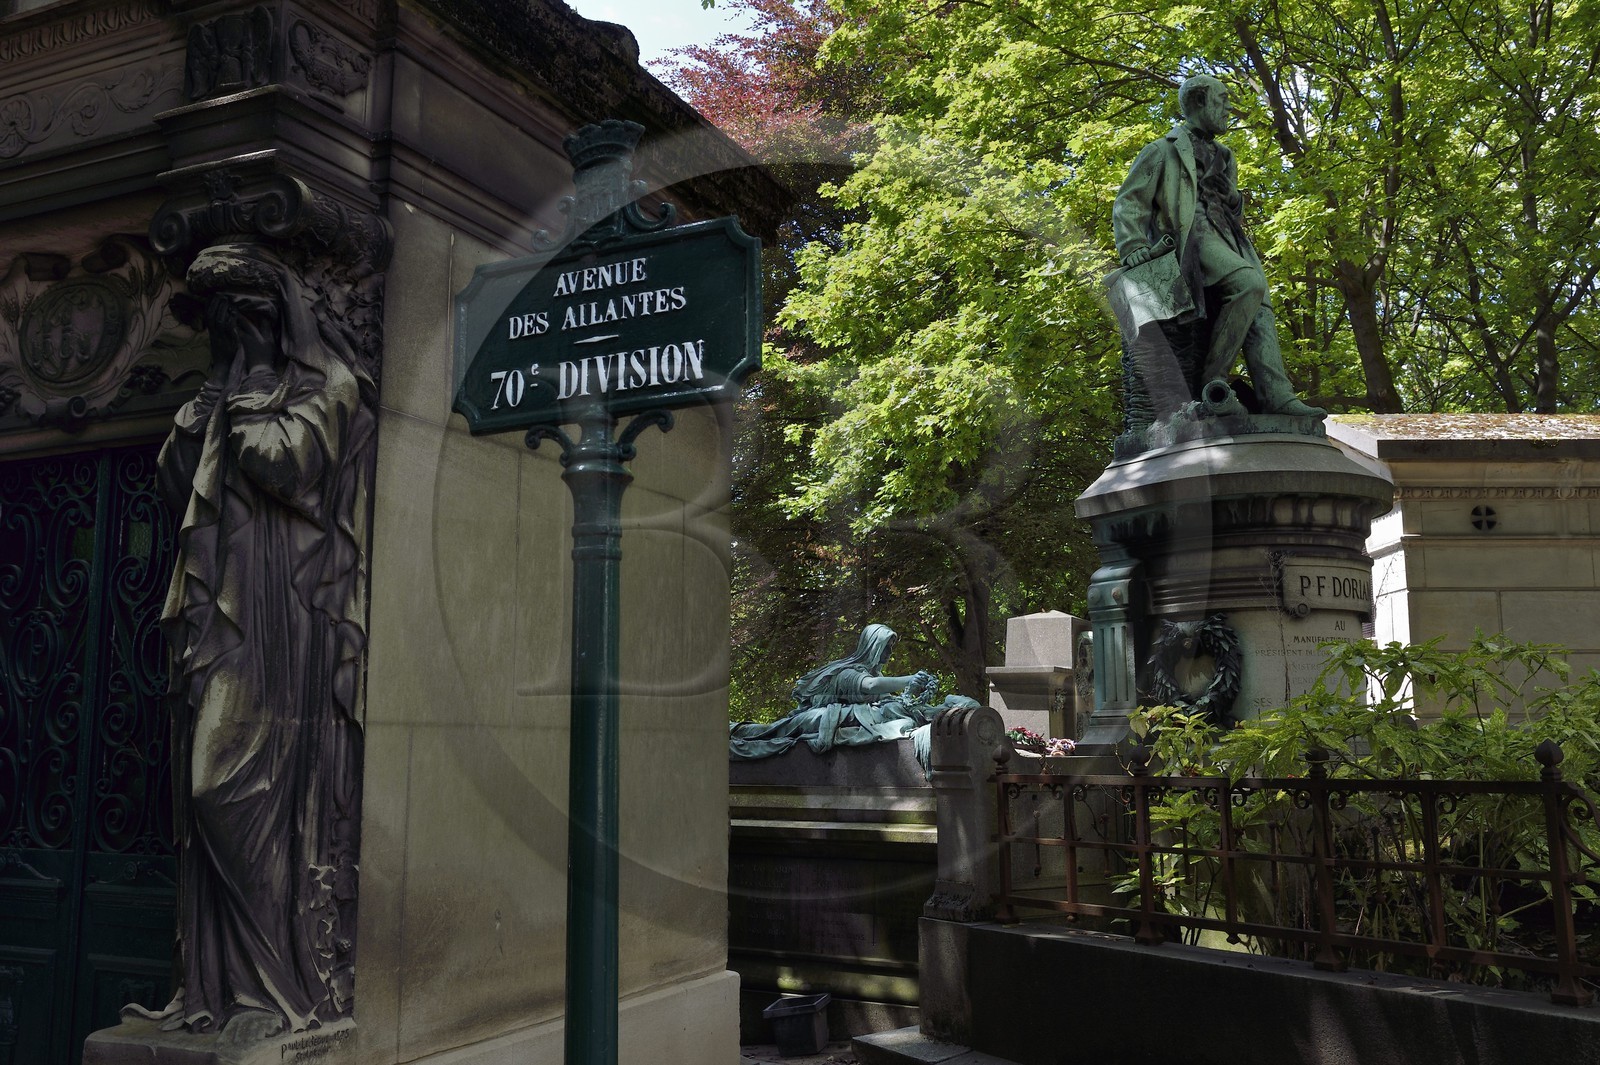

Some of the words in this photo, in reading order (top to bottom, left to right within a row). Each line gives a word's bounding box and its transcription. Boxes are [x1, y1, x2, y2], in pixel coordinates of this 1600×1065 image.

[553, 257, 647, 297] AVENUE
[508, 311, 550, 340] DES
[561, 286, 687, 330] AILANTES
[556, 339, 705, 400] DIVISION
[1334, 620, 1346, 631] AU
